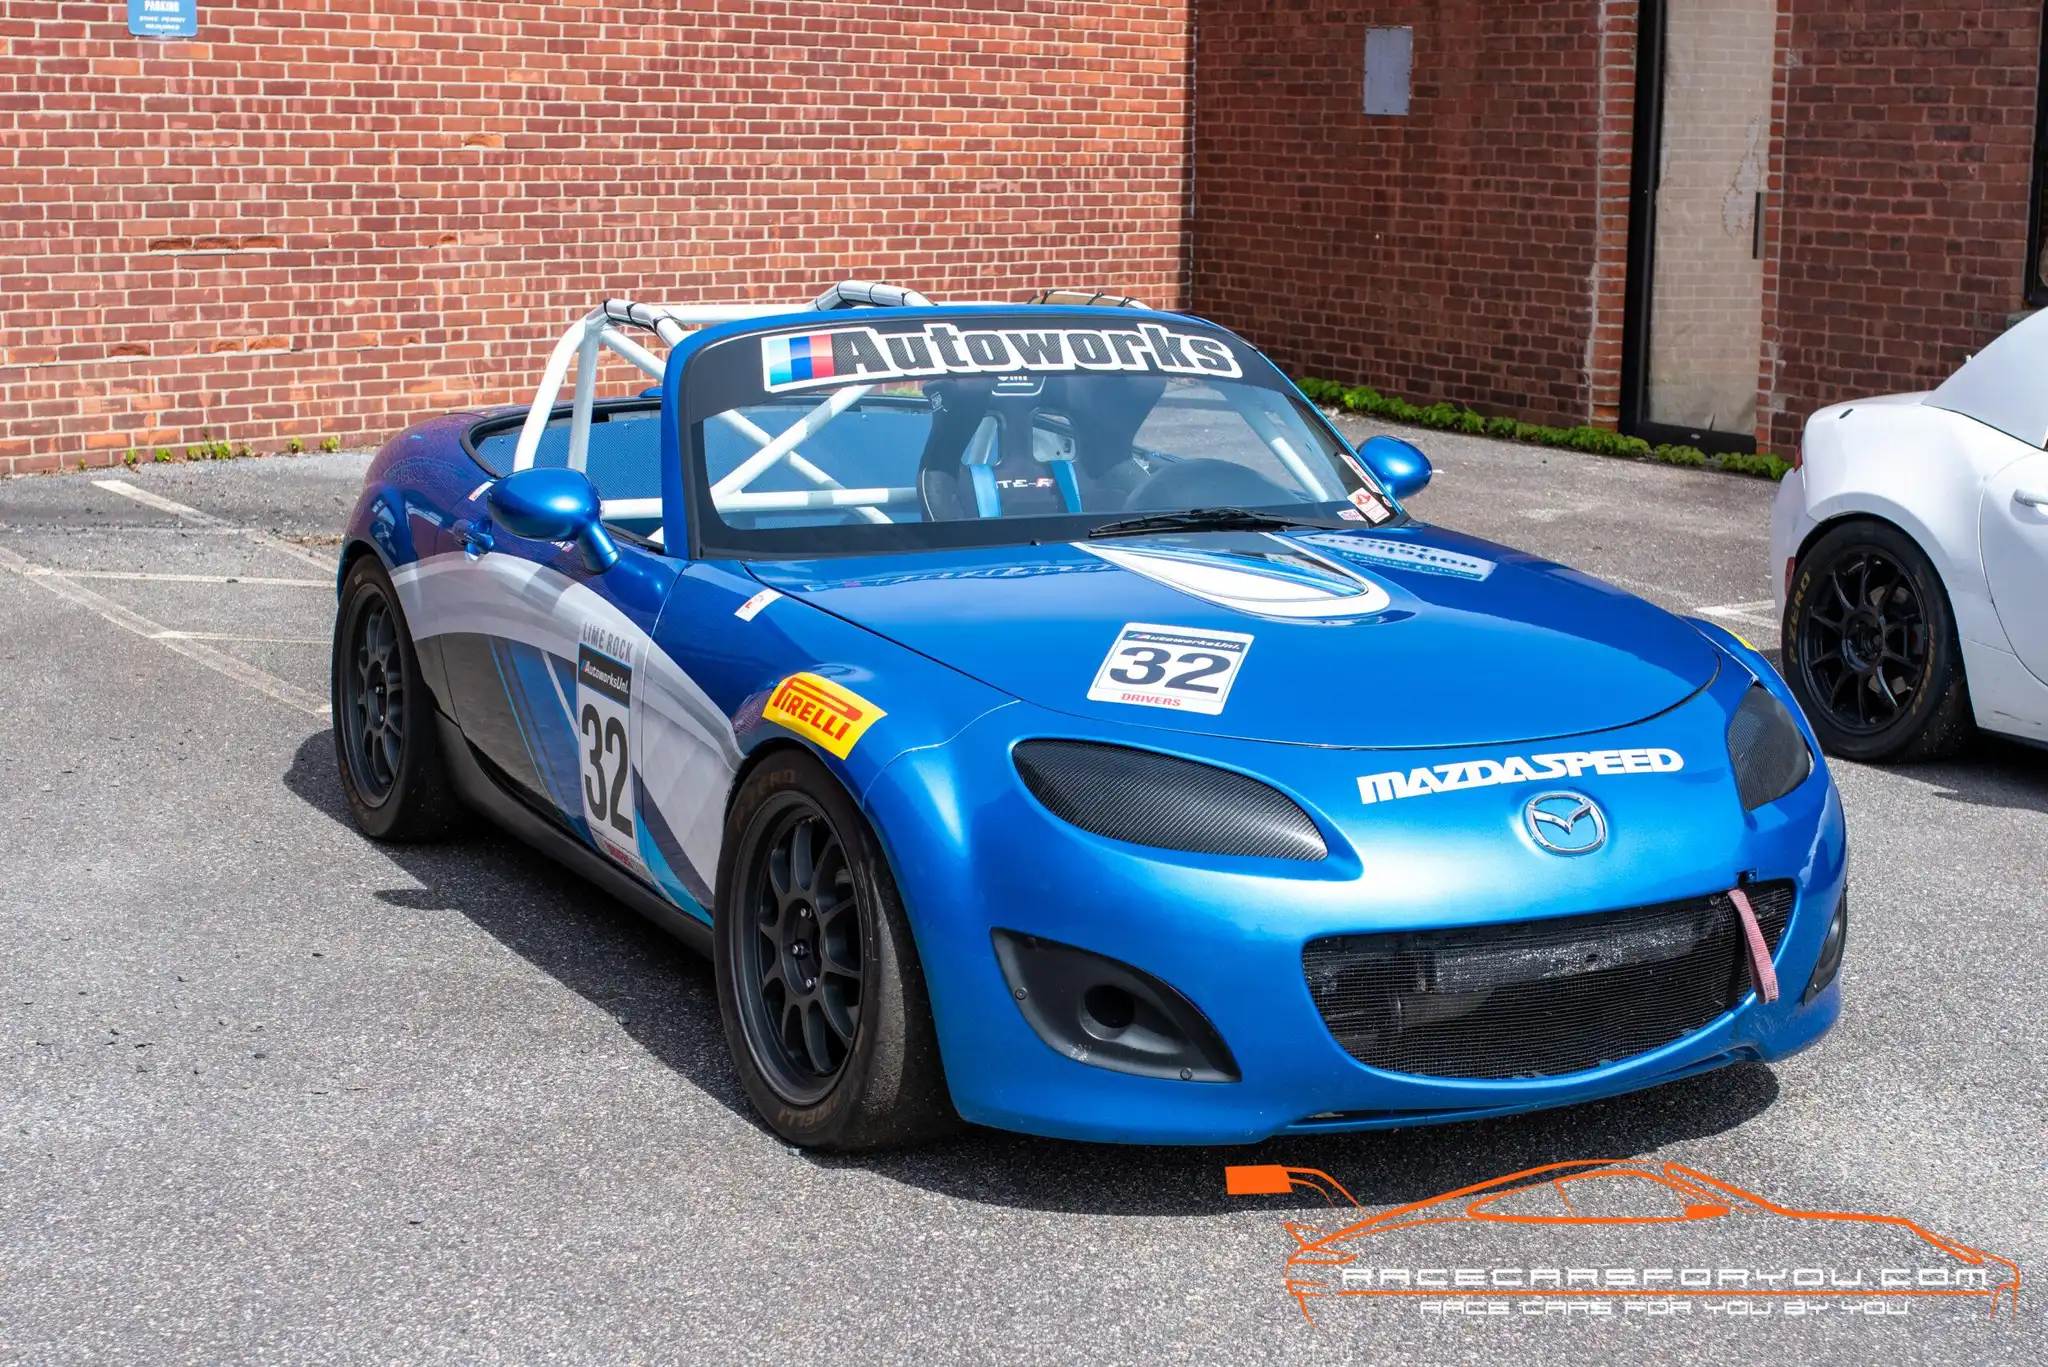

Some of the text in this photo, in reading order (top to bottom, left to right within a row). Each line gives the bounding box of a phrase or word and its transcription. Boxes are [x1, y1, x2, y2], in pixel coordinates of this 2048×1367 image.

[832, 324, 1242, 377] Autoworks
[583, 622, 633, 663] LIME ROCK
[1110, 646, 1231, 694] 32
[773, 677, 863, 741] PIRELLI
[1121, 693, 1181, 707] DRIVERS
[581, 703, 634, 840] 32
[1356, 748, 1685, 804] MAZDASPEED
